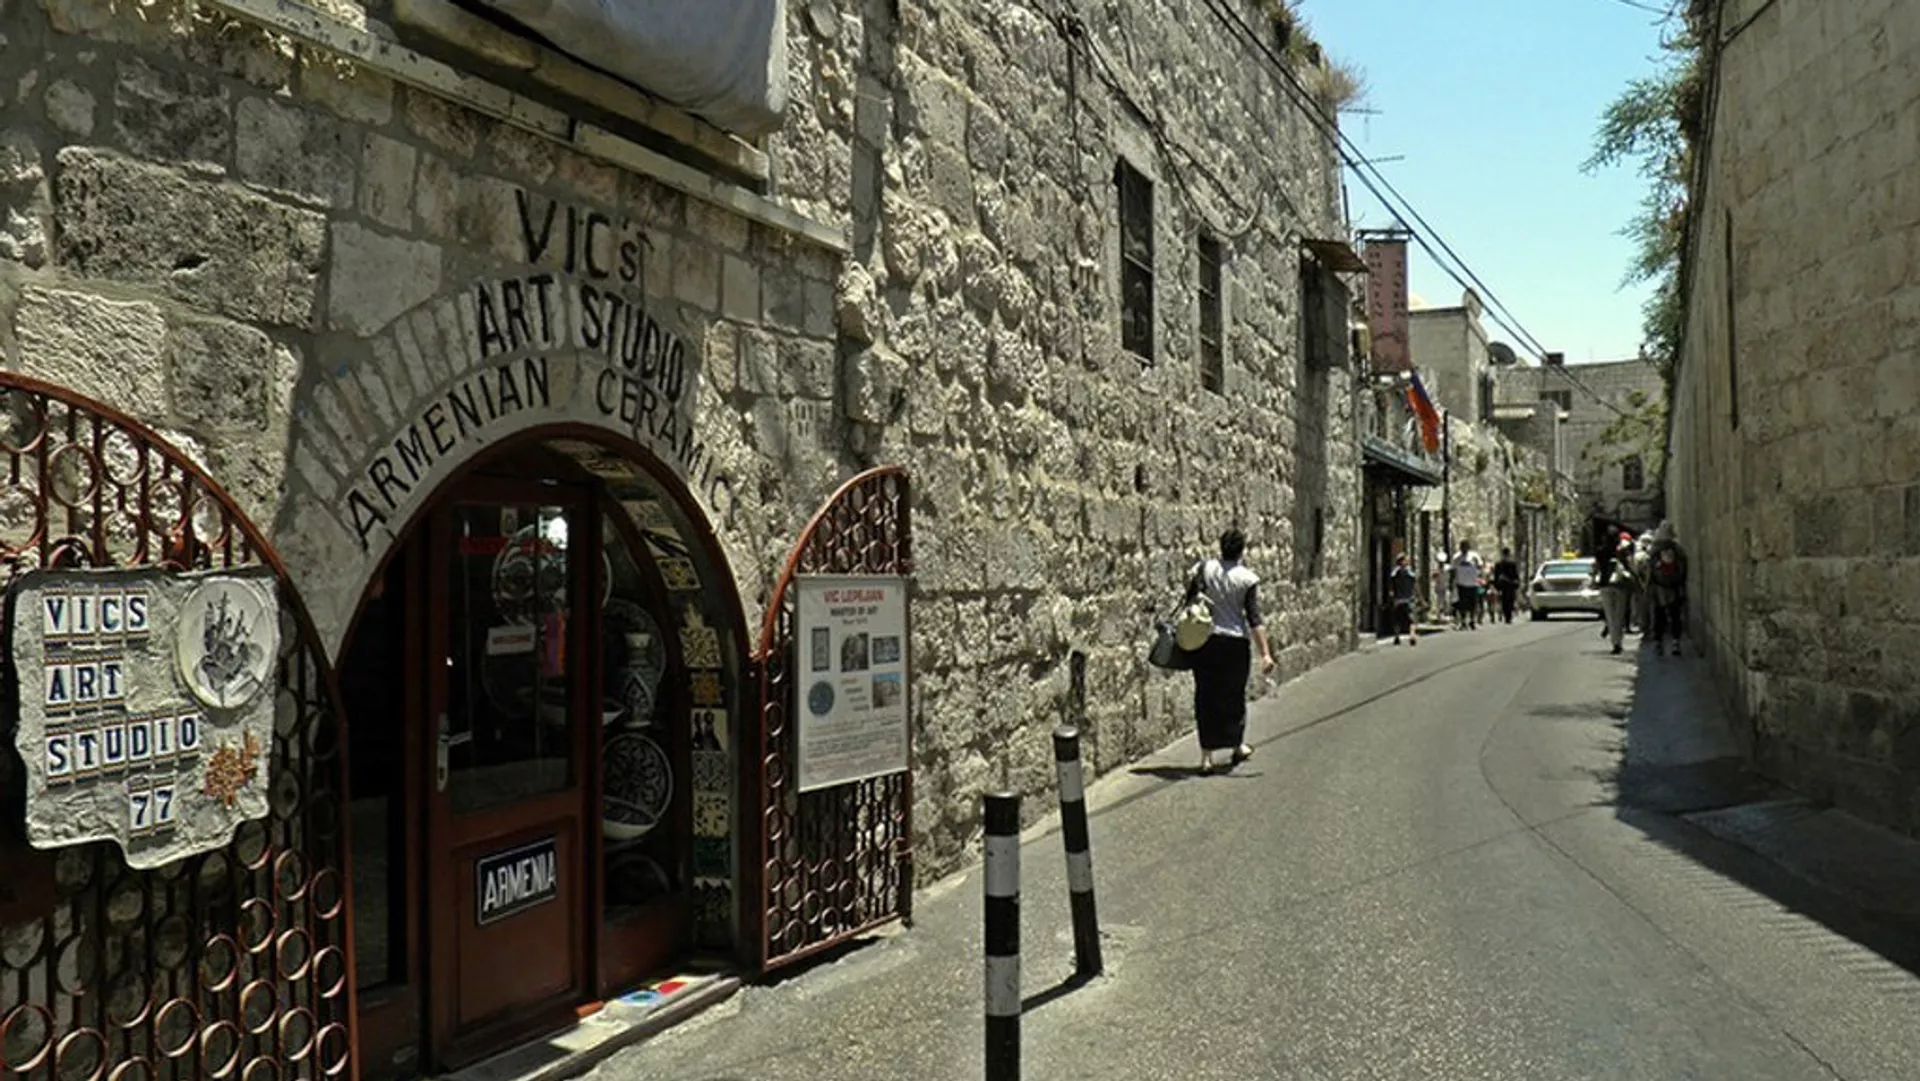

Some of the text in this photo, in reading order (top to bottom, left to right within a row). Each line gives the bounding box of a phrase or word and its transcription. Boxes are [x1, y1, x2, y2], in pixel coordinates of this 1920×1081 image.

[476, 274, 685, 403] ART STUDIO
[346, 356, 551, 553] ARMENIAN
[45, 596, 147, 630] VICS
[48, 664, 122, 702] ART
[48, 716, 197, 772] STUDIO
[131, 789, 173, 826] 77
